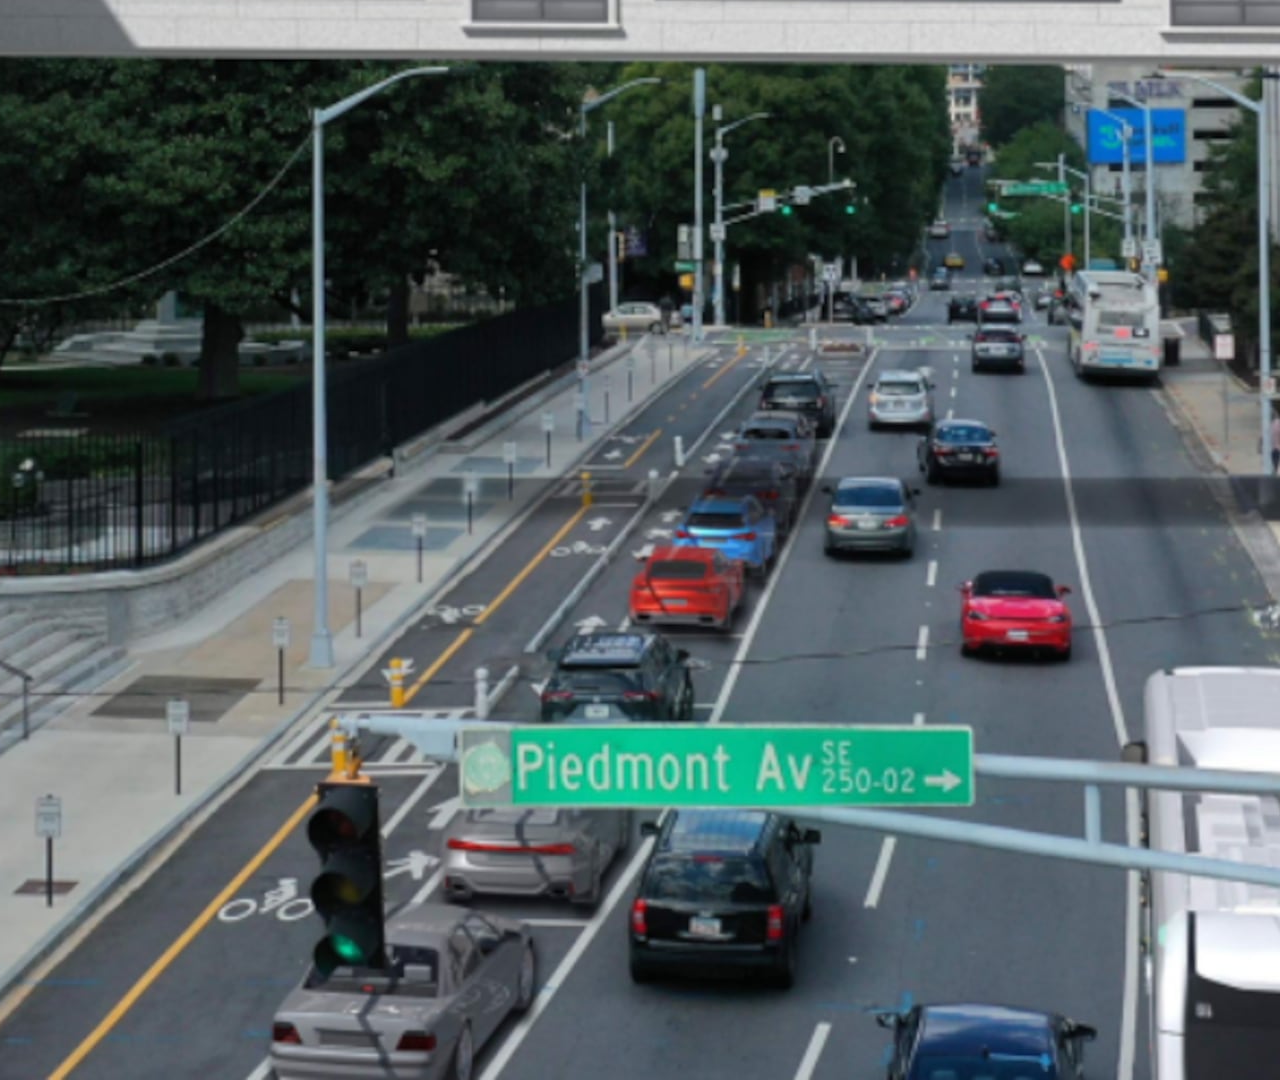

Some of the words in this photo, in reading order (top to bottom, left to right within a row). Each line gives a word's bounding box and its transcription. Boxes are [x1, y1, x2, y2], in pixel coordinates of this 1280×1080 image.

[822, 740, 852, 766] SE
[517, 741, 731, 792] Piedmont
[755, 741, 812, 791] Av
[822, 768, 915, 794] 250-02
